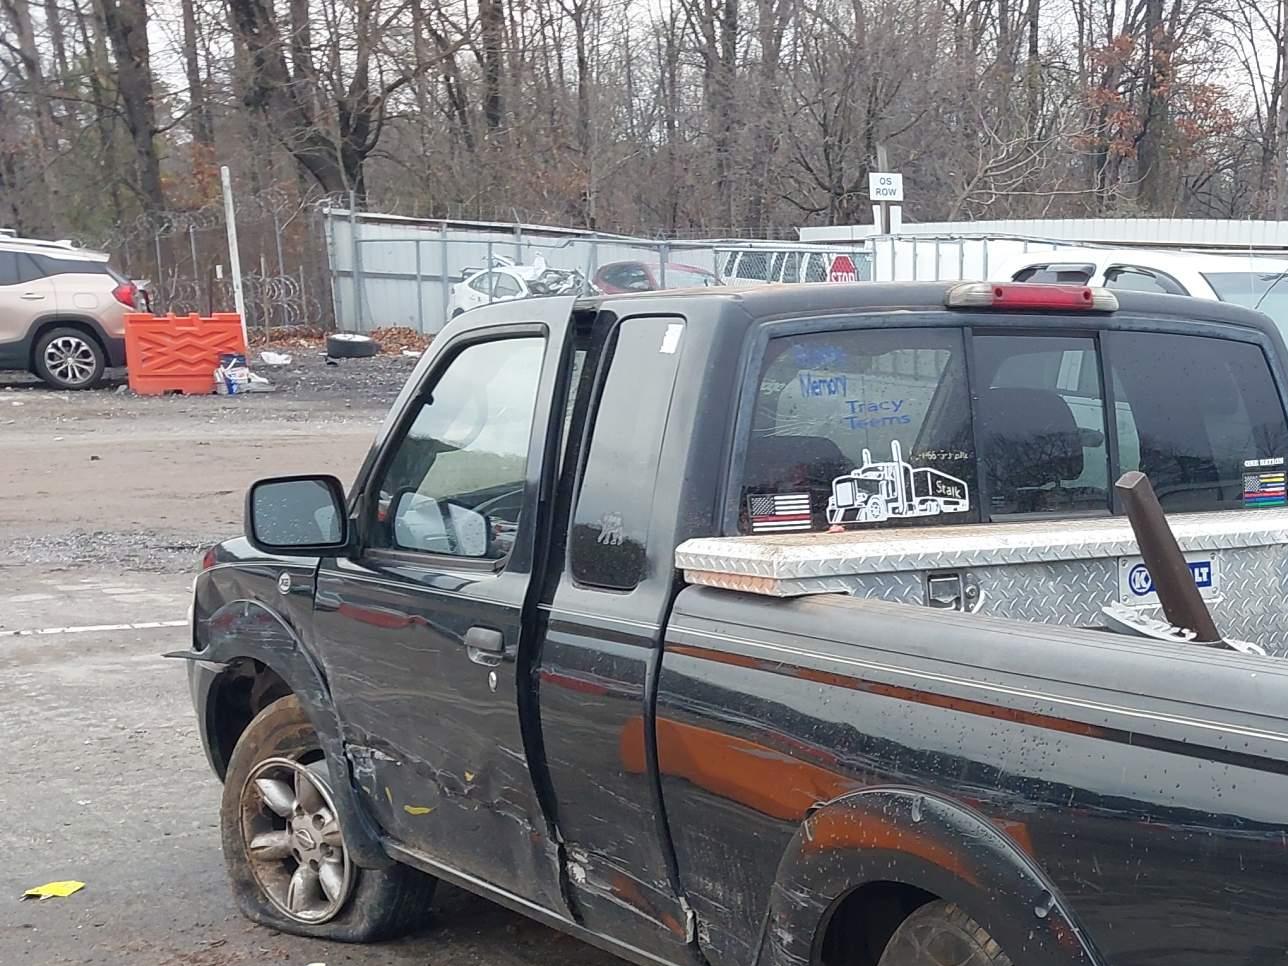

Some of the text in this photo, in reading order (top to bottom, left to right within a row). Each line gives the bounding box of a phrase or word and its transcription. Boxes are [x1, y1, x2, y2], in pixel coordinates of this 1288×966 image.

[875, 187, 897, 197] ROW
[845, 399, 903, 414] Tracy
[935, 480, 962, 499] Stalk
